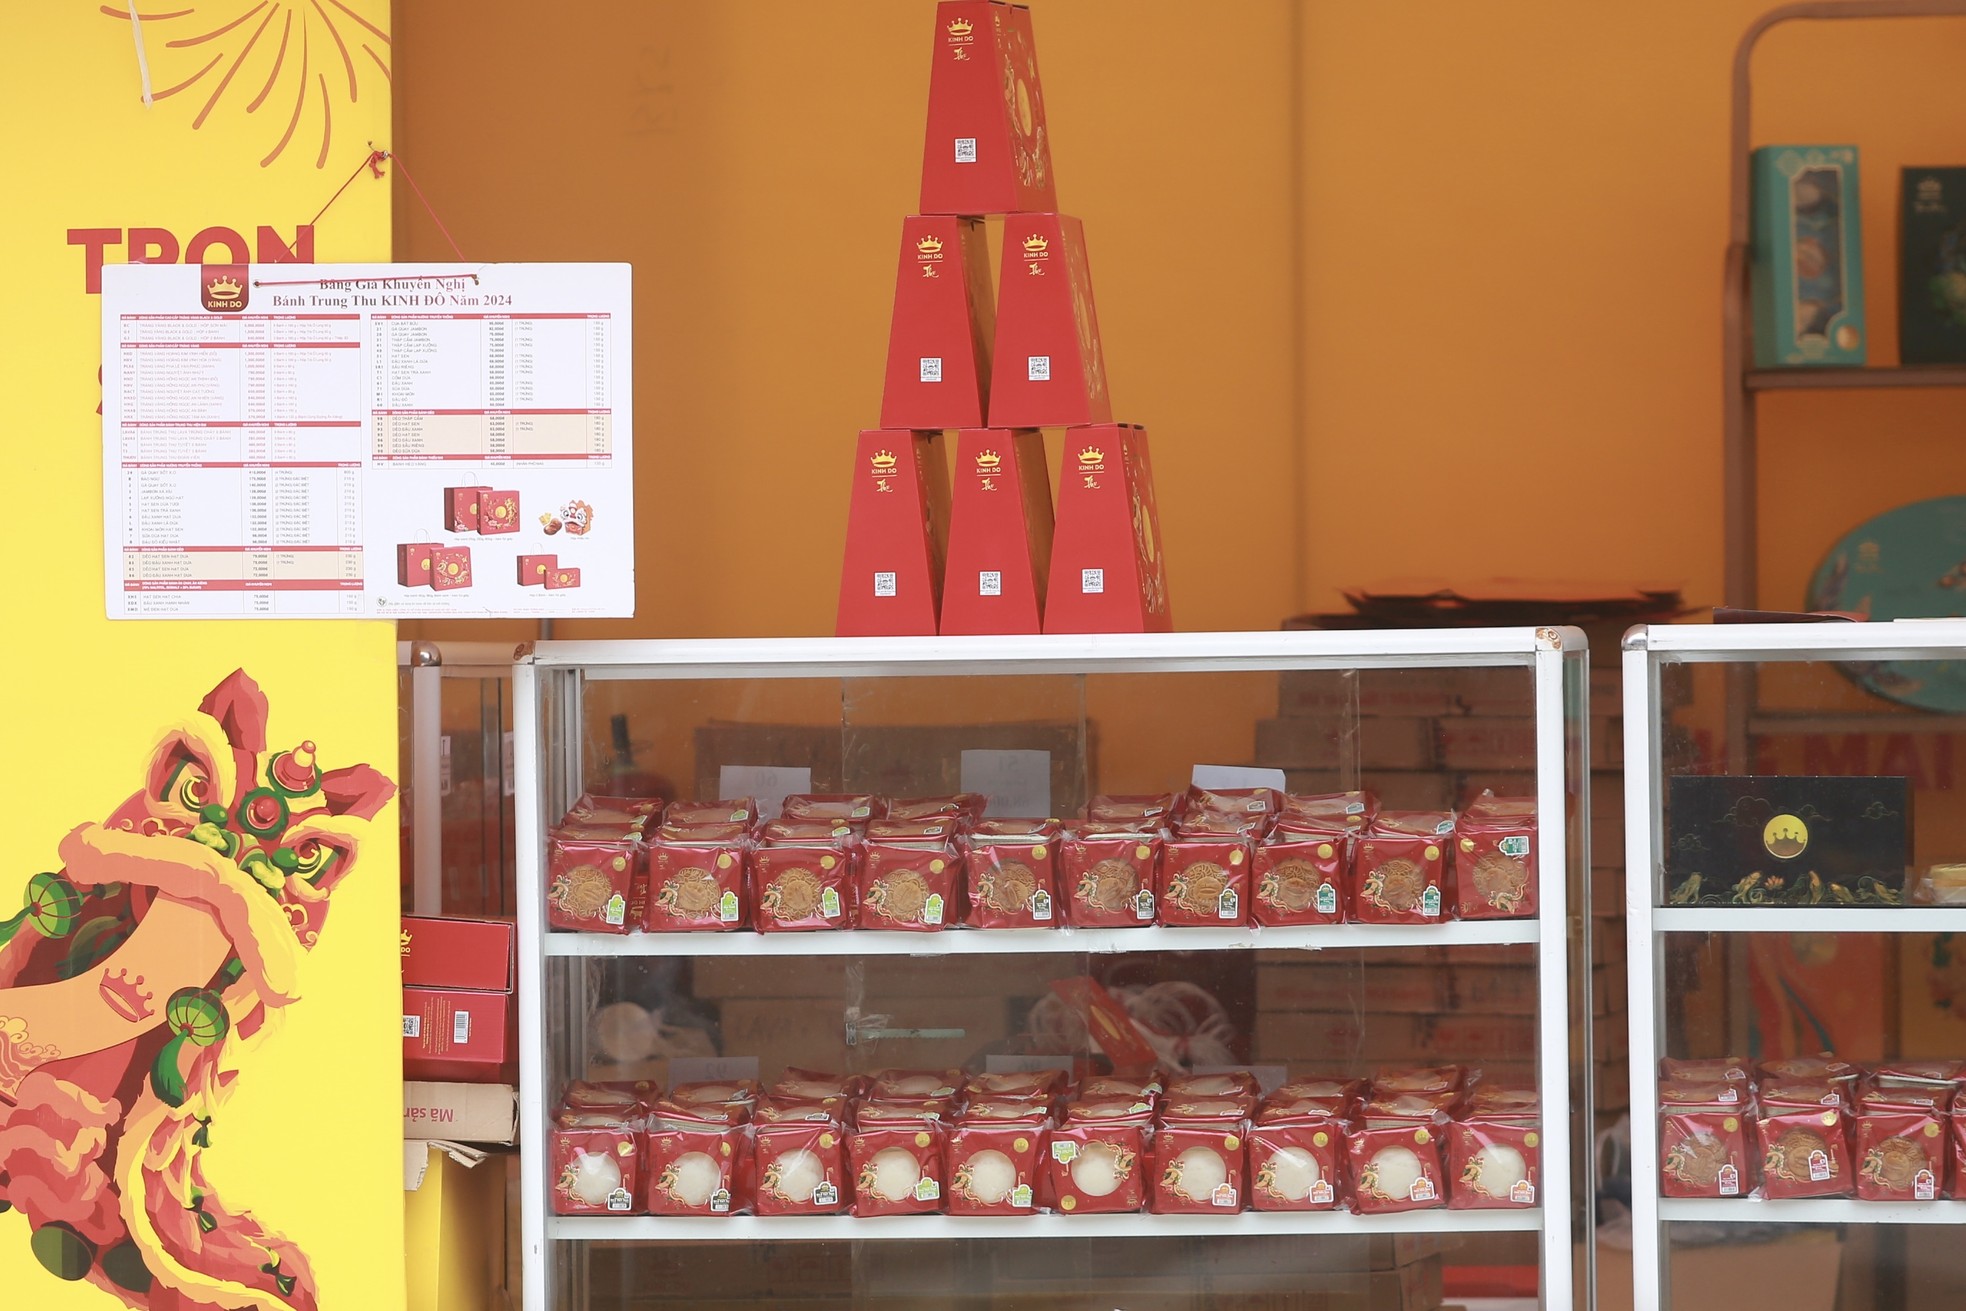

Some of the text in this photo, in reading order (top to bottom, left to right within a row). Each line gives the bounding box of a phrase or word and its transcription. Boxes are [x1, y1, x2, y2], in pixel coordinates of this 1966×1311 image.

[435, 279, 465, 292] Nghị
[273, 292, 512, 308] Bánh Trung Thu KINH ĐÔ Năm 2024
[430, 1108, 454, 1122] Mã
